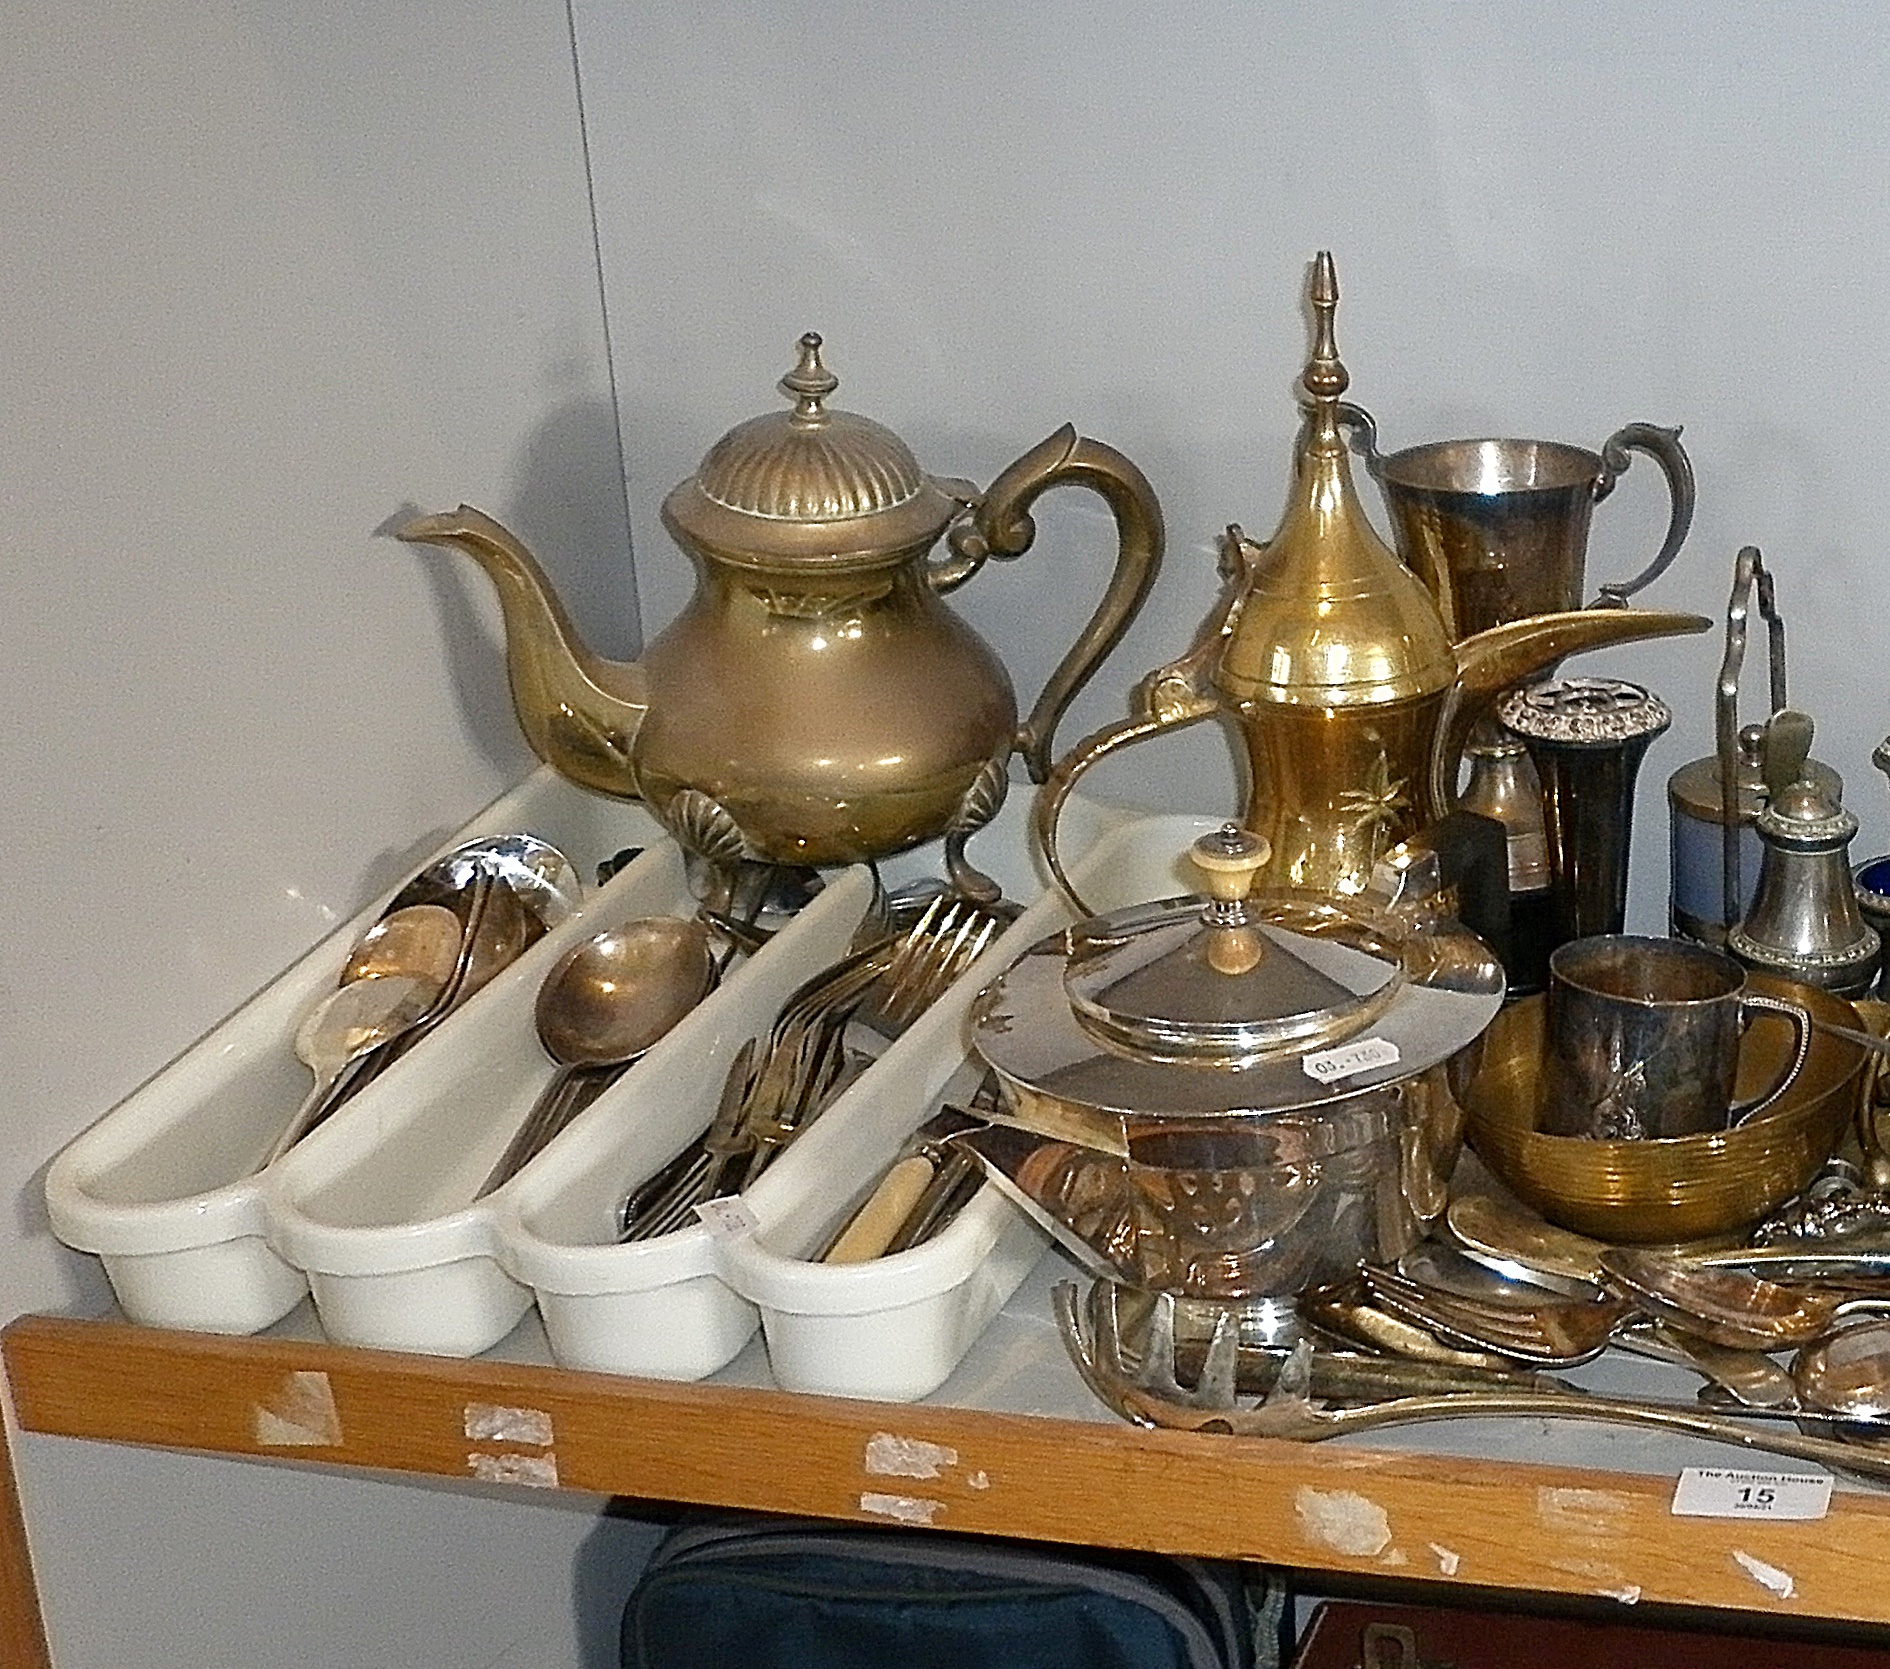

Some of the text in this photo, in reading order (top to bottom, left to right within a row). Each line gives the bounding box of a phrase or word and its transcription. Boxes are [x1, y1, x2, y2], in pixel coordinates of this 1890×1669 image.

[1699, 1470, 1722, 1479] The
[1725, 1471, 1777, 1482] Auction
[1781, 1473, 1824, 1485] House
[1738, 1487, 1775, 1504] 15
